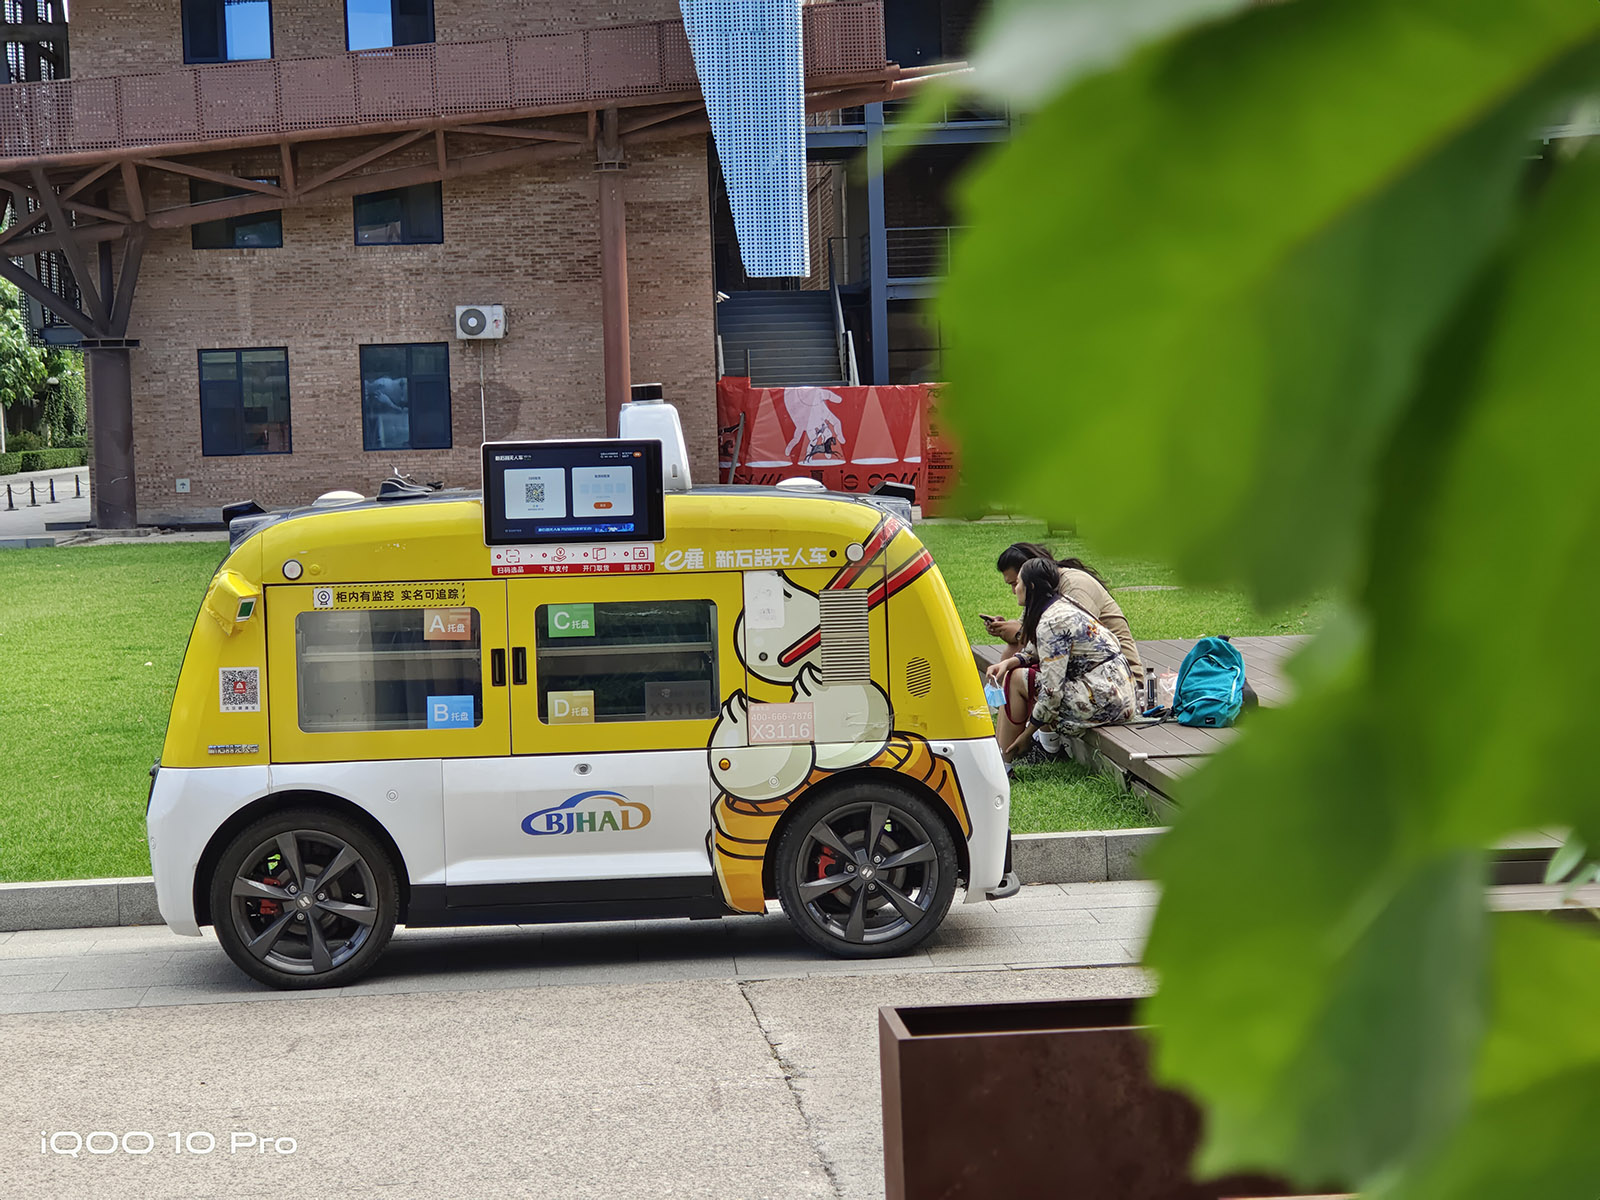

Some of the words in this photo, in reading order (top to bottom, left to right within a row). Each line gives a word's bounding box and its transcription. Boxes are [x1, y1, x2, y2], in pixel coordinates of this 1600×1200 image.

[715, 547, 828, 568] 新石器无人车
[541, 565, 569, 573] 下单支付
[582, 564, 610, 572] 开门取货
[336, 590, 395, 603] 柜内有监控
[401, 588, 460, 601] 实名可追踪
[429, 615, 445, 633] A
[447, 623, 465, 633] 托盘
[553, 611, 570, 630] C
[571, 619, 589, 630] 托盘
[433, 703, 449, 722] B
[450, 711, 469, 722] 托盘
[554, 699, 570, 717] D
[571, 707, 589, 717] 托盘
[650, 701, 706, 716] X3116
[751, 711, 813, 721] 400-666-7876
[752, 723, 810, 740] X3116
